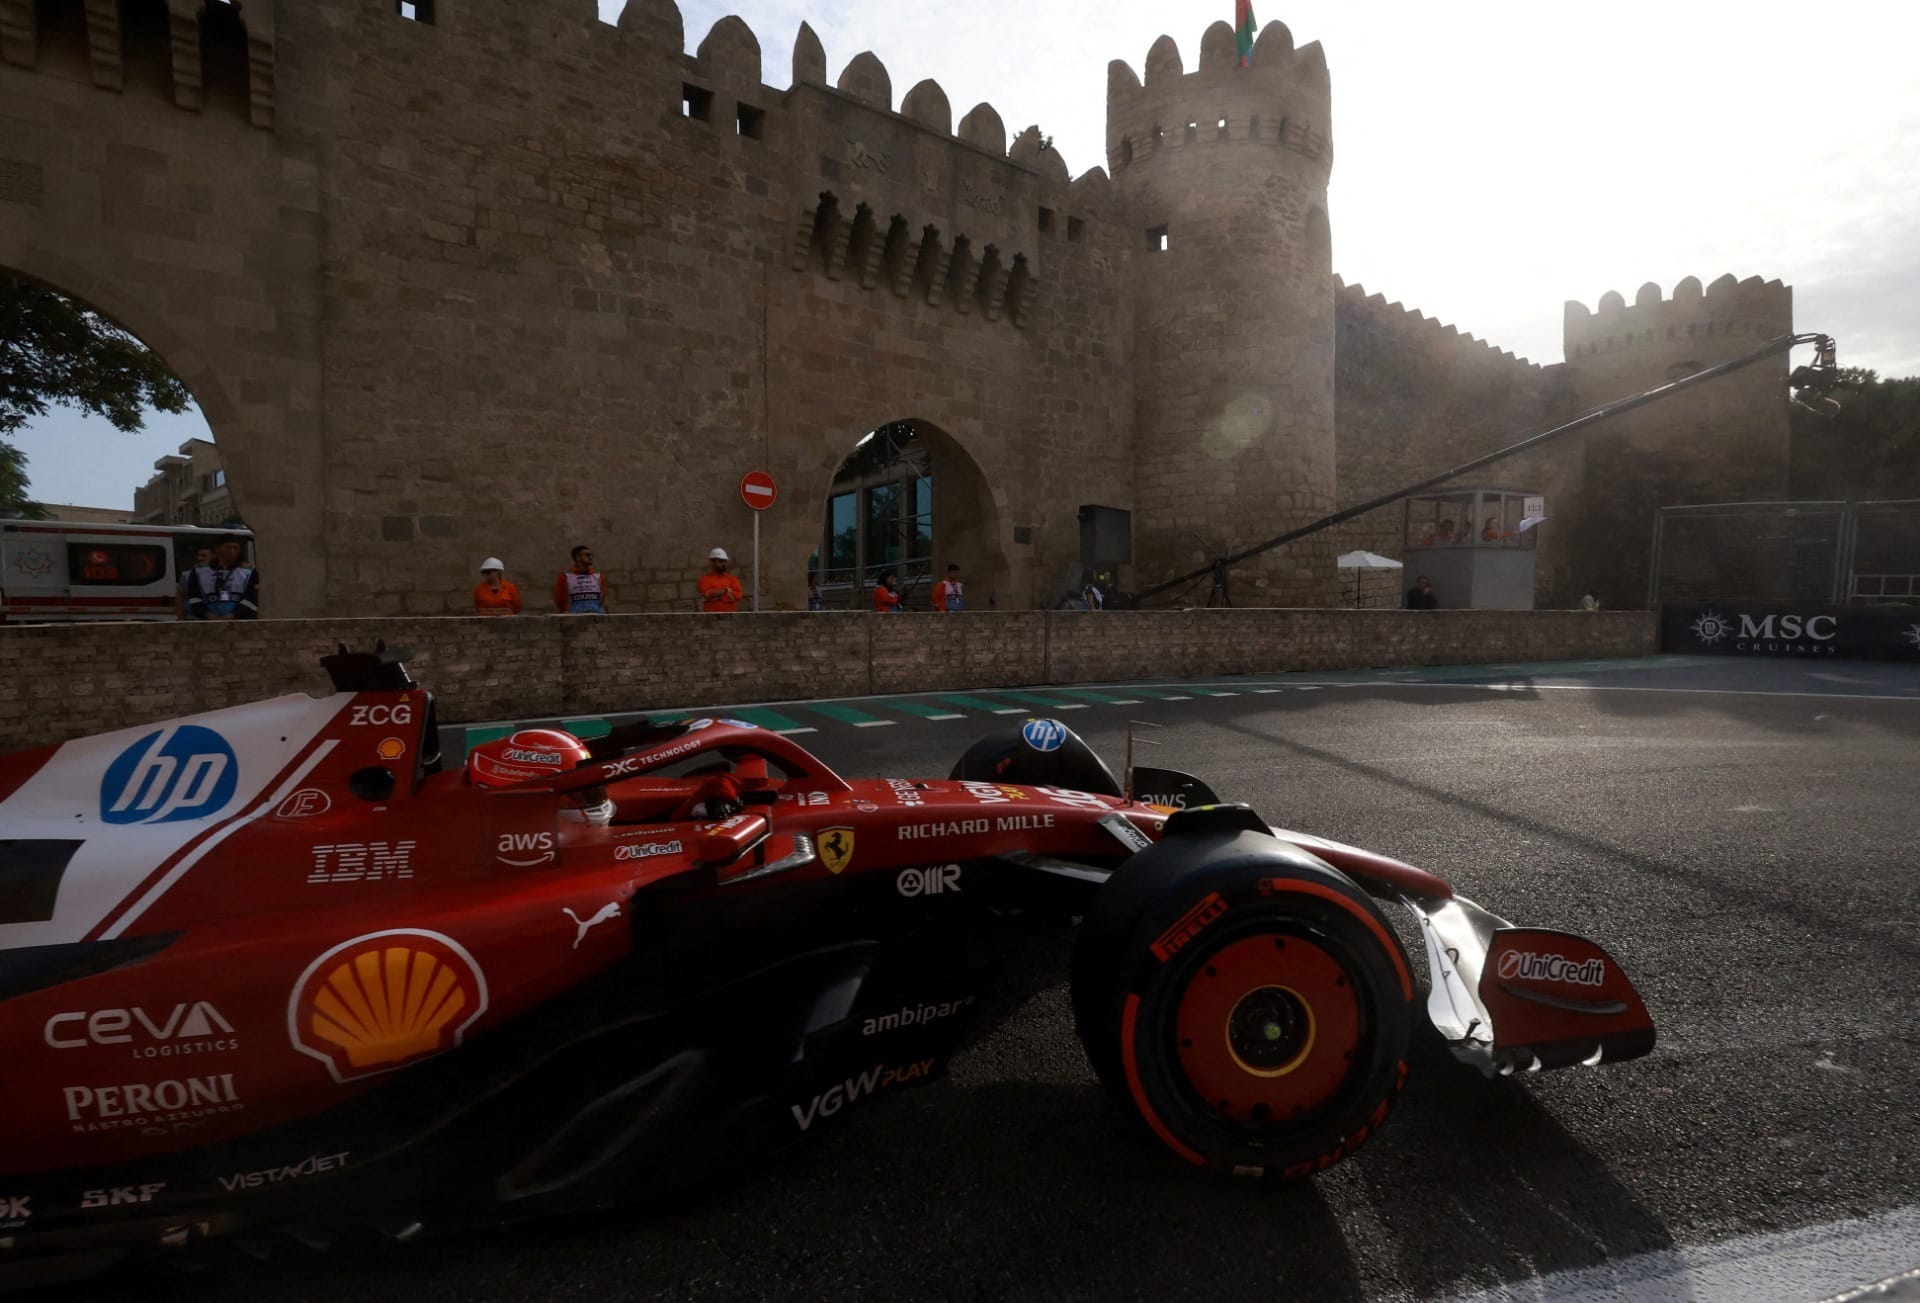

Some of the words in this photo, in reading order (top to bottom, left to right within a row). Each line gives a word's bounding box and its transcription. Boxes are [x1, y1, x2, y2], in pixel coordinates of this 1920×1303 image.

[1737, 613, 1838, 641] MSC
[1736, 642, 1836, 655] CRUISES
[349, 704, 412, 726] ZCG
[1030, 720, 1061, 751] hp
[512, 750, 562, 765] UniCredit
[640, 739, 702, 766] TECHNOLOGY
[108, 726, 229, 824] hp
[897, 818, 990, 841] RICHARD
[996, 814, 1056, 832] MILLE
[498, 831, 553, 852] aws
[629, 840, 683, 859] UniCredit
[306, 840, 417, 884] IBM
[1518, 952, 1606, 987] UniCredit
[861, 1003, 962, 1037] ambipar
[132, 1038, 239, 1059] LOGISTICS
[63, 1073, 241, 1121] PERONI
[81, 1181, 168, 1208] SKF
